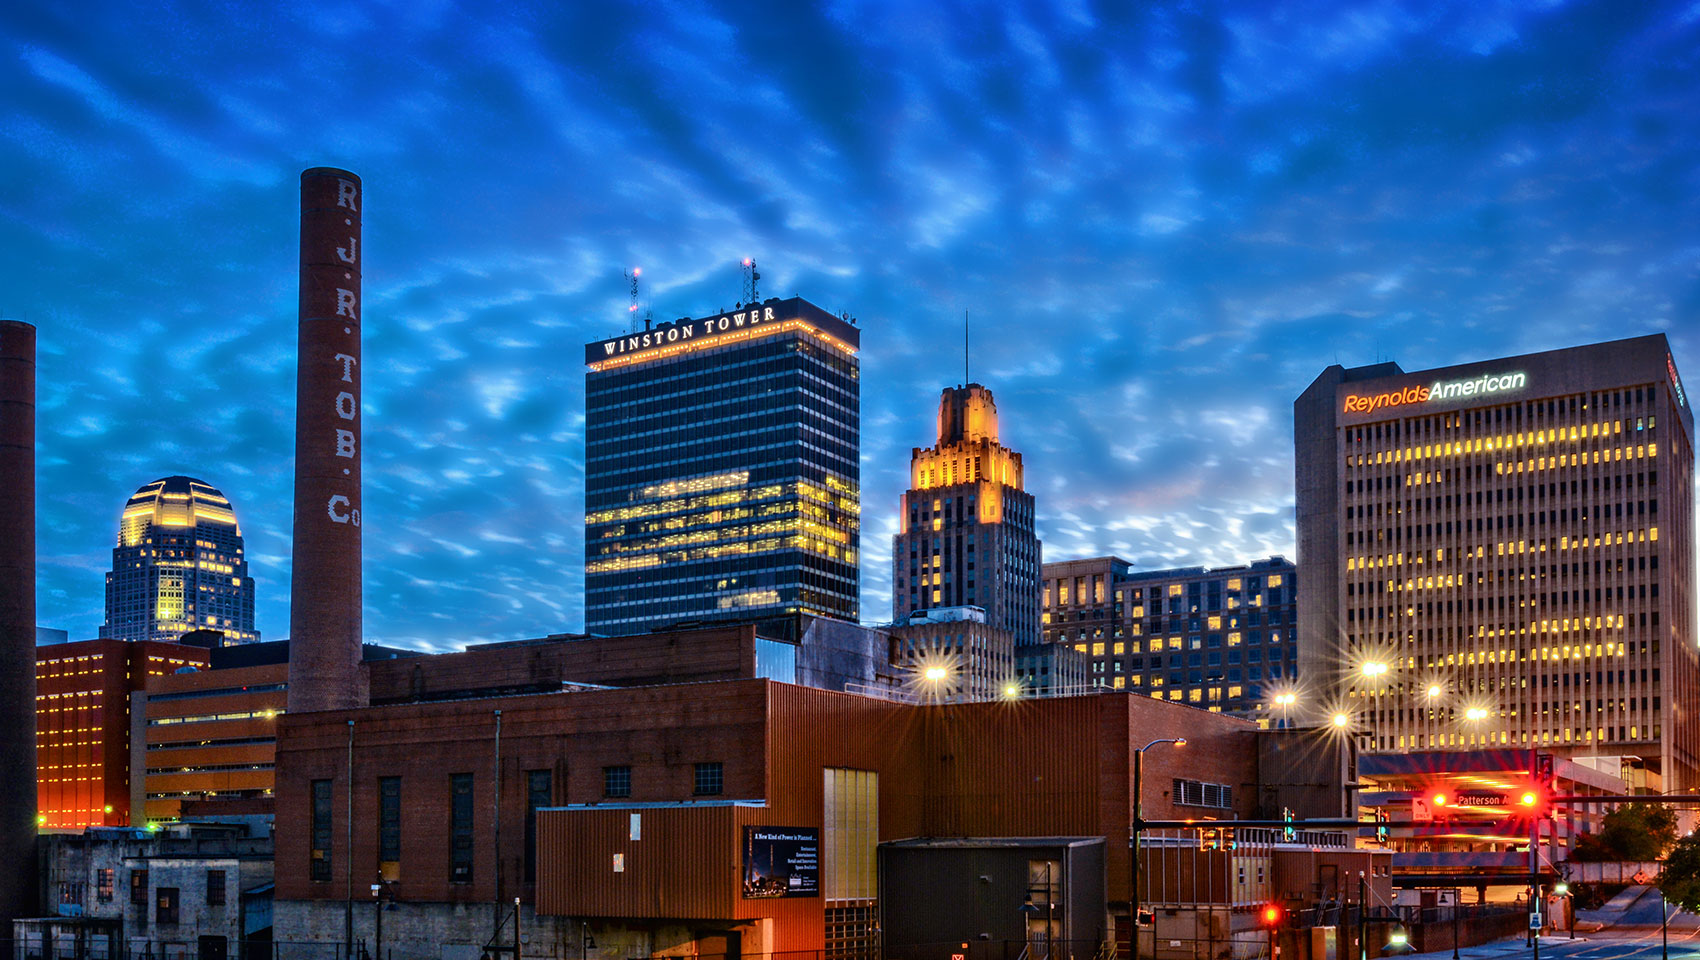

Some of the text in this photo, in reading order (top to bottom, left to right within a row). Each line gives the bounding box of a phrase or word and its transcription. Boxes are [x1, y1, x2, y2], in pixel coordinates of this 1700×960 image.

[604, 307, 776, 356] WINSTON TOWER
[1458, 795, 1500, 805] Patterson
